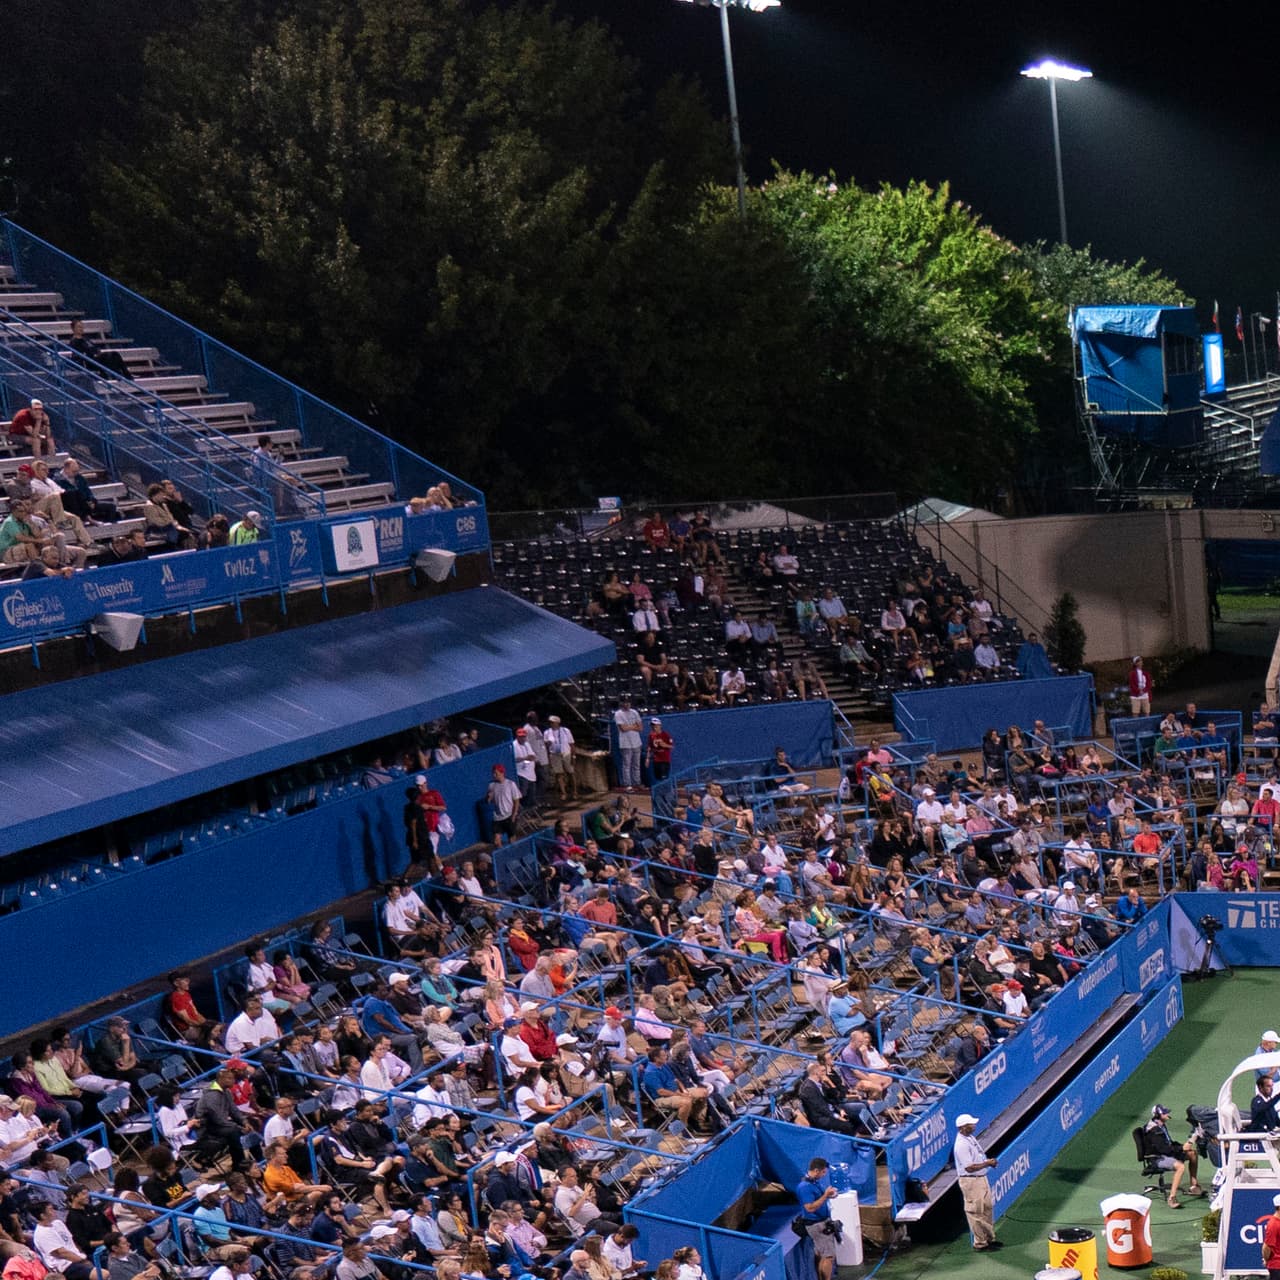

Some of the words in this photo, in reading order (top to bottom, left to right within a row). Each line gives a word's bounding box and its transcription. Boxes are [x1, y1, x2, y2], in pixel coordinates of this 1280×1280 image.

[97, 578, 134, 600] Insperity
[1165, 990, 1178, 1028] citi
[974, 1051, 1006, 1095] GEICO
[919, 1108, 947, 1146] TENNIS
[1243, 1143, 1259, 1152] citi
[1106, 1219, 1134, 1254] G
[1240, 1224, 1267, 1244] ci
